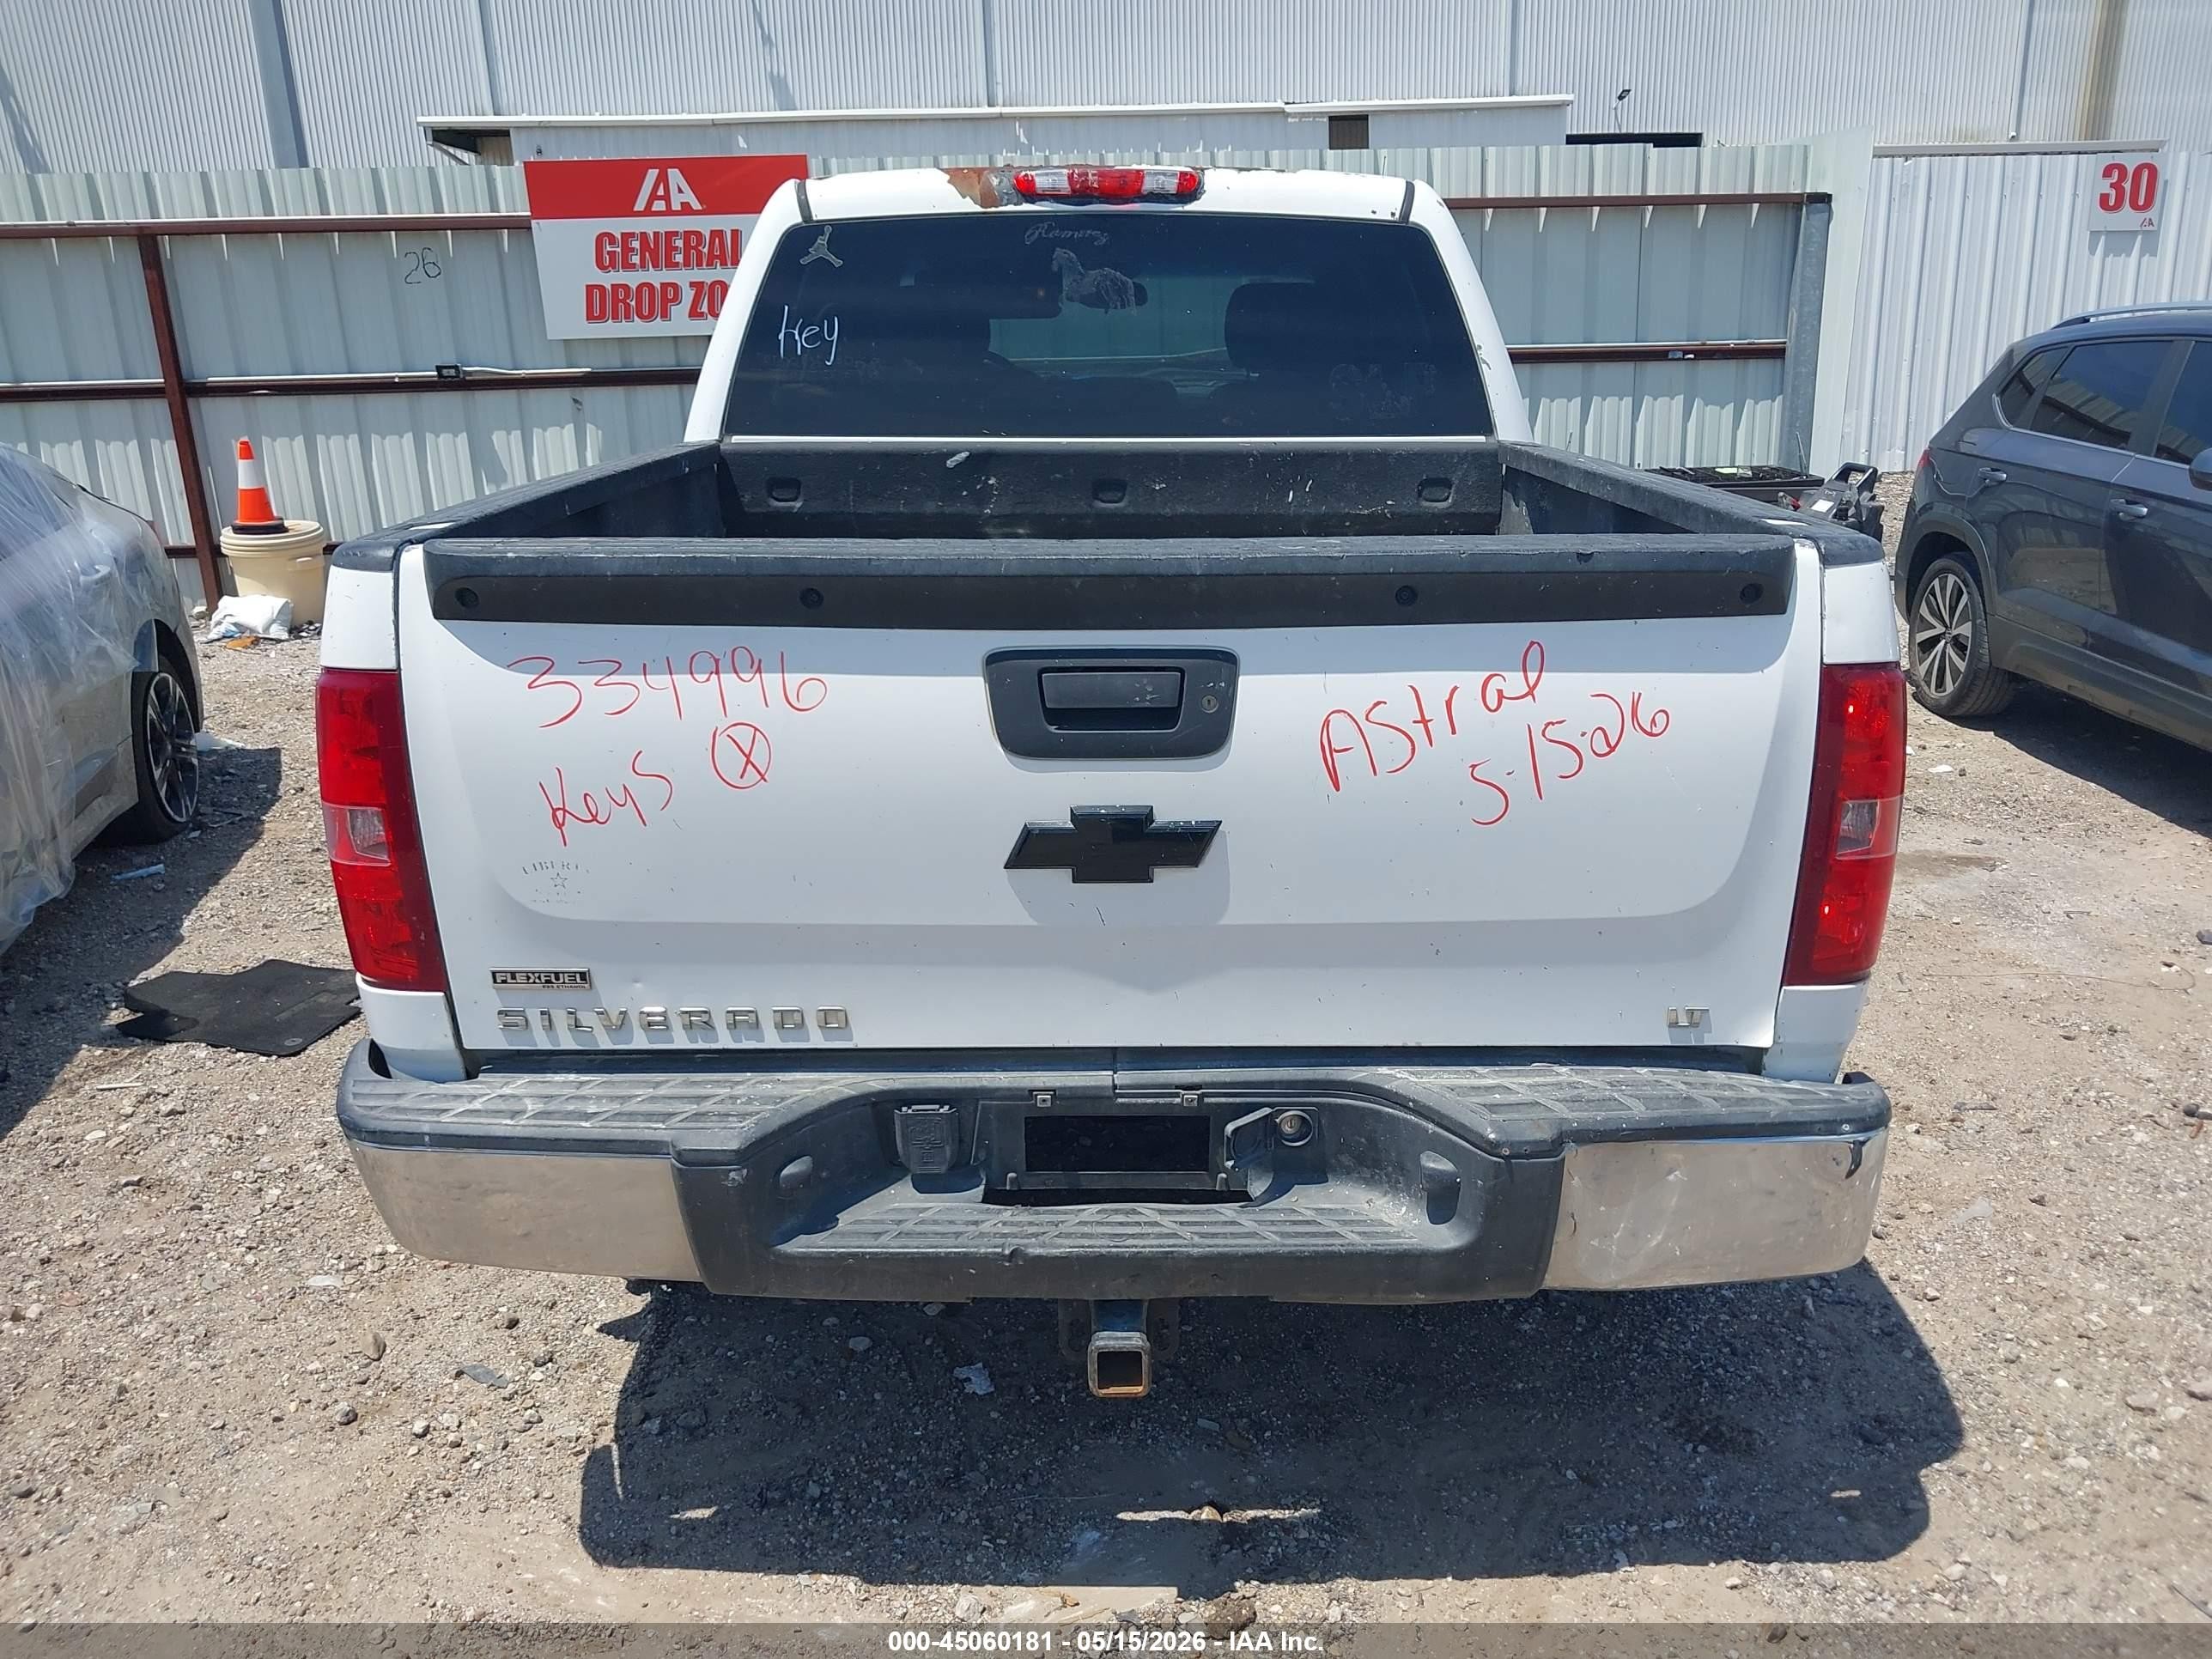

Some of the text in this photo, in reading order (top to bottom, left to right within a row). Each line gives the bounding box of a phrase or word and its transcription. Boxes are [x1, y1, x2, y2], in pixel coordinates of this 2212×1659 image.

[634, 168, 702, 212] IAA
[2099, 162, 2159, 213] 30
[404, 247, 441, 285] 26
[594, 228, 742, 273] GENERAL
[585, 279, 730, 324] DROP ZO
[506, 646, 828, 729] 334996
[495, 972, 586, 983] FLEXFUEL
[497, 1006, 848, 1032] SILVERADO
[1668, 1006, 1710, 1028] LT
